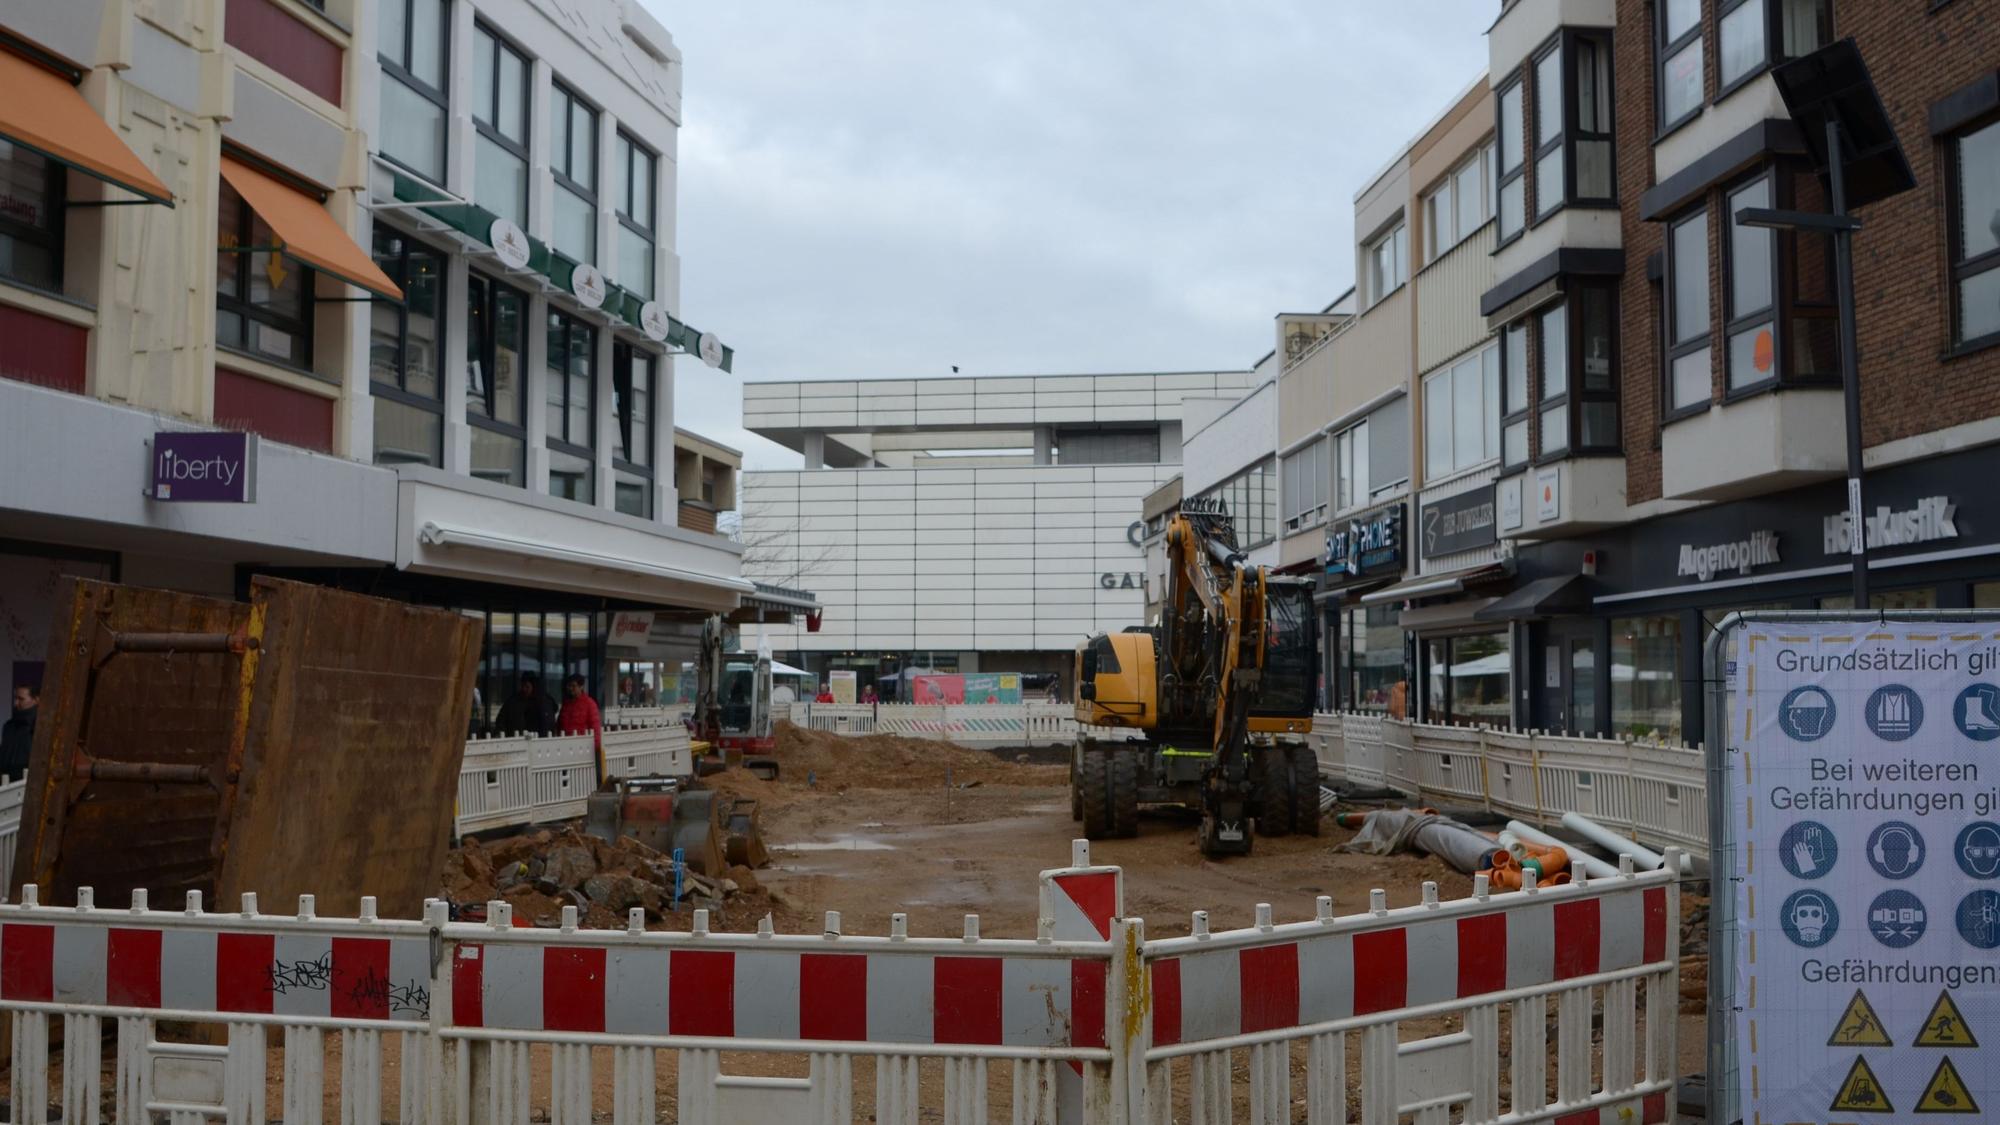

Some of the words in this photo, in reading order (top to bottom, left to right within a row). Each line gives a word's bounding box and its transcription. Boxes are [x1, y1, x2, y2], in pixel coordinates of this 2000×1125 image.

[159, 448, 239, 486] liberty
[1824, 496, 1958, 555] Höakustik
[1677, 530, 1781, 581] Augenoptik
[1776, 648, 1958, 673] Grundsätzlich
[1968, 646, 2000, 676] gil
[1810, 758, 1853, 781] Bei
[1862, 758, 1978, 781] weiteren
[1770, 786, 1964, 816] Gefährdungen
[1974, 786, 2000, 816] gi
